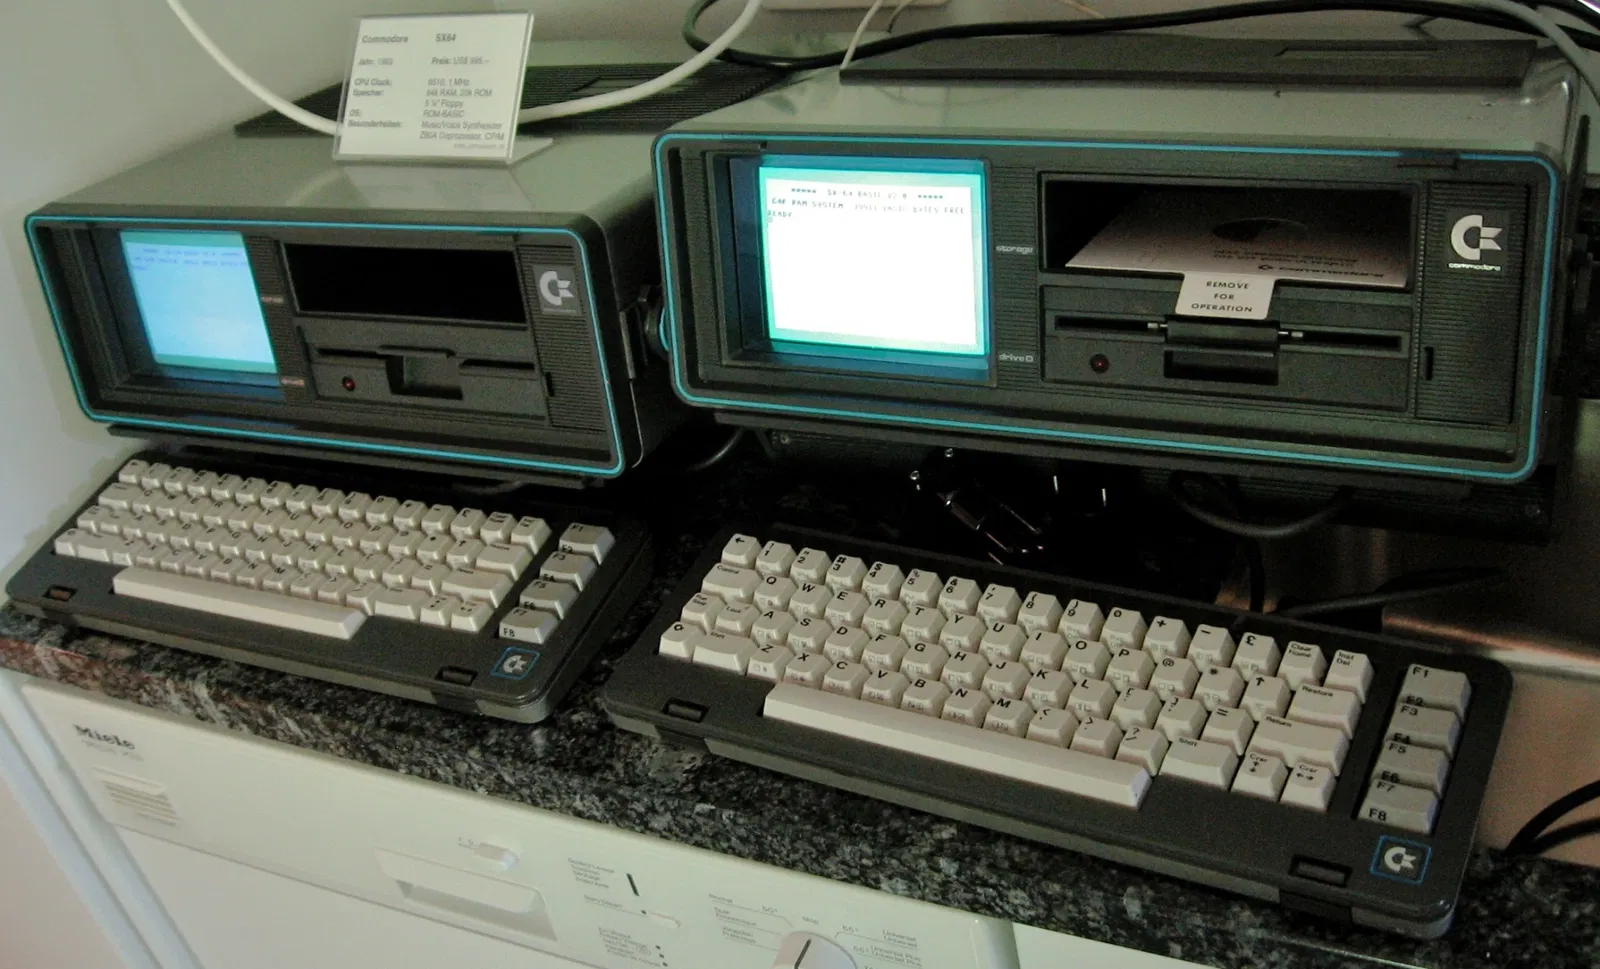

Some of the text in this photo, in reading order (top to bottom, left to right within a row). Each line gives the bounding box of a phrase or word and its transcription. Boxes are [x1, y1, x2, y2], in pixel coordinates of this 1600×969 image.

[361, 33, 457, 44] Commodore SX64
[454, 78, 470, 86] MHz
[473, 89, 492, 97] ROM
[441, 99, 464, 109] Floppy
[791, 199, 808, 207] RAM
[812, 201, 844, 209] SYSTEM
[995, 245, 1034, 255] storage
[1206, 280, 1249, 290] REMOVE
[1214, 293, 1235, 301] FOR
[1191, 303, 1253, 313] OPERATION
[999, 353, 1024, 362] drive
[797, 556, 806, 564] 2
[836, 556, 847, 564] #
[832, 563, 841, 571] 3
[869, 570, 877, 578] 4
[946, 585, 954, 594] 6
[1026, 601, 1035, 609] 8
[1067, 608, 1076, 617] 9
[801, 583, 816, 593] W
[836, 591, 848, 600] E
[874, 599, 886, 609] R
[914, 606, 924, 616] T
[953, 614, 964, 624] Y
[992, 622, 1004, 633] U
[1075, 640, 1087, 650] O
[1118, 649, 1130, 658] P
[1162, 658, 1175, 667] @
[1156, 619, 1166, 628] +
[503, 628, 515, 637] F8
[1245, 635, 1256, 646] £
[1336, 658, 1351, 666] Del
[763, 610, 774, 619] A
[800, 618, 811, 627] S
[836, 627, 848, 636] D
[875, 634, 886, 643] F
[914, 643, 926, 652] G
[953, 652, 967, 661] H
[996, 661, 1007, 670] J
[1036, 669, 1049, 680] K
[1081, 679, 1090, 689] L
[1265, 715, 1293, 728] Return
[1412, 666, 1428, 678] F1
[760, 644, 773, 653] Z
[799, 653, 810, 662] X
[836, 661, 848, 670] C
[876, 670, 887, 679] V
[914, 678, 926, 688] B
[955, 688, 968, 698] N
[996, 698, 1012, 708] M
[1132, 727, 1140, 735] ?
[1401, 705, 1418, 716] F3
[1393, 732, 1411, 744] F4
[1389, 742, 1407, 754] F5
[1381, 771, 1399, 783] F6
[1376, 781, 1396, 792] F7
[1369, 808, 1387, 821] F8
